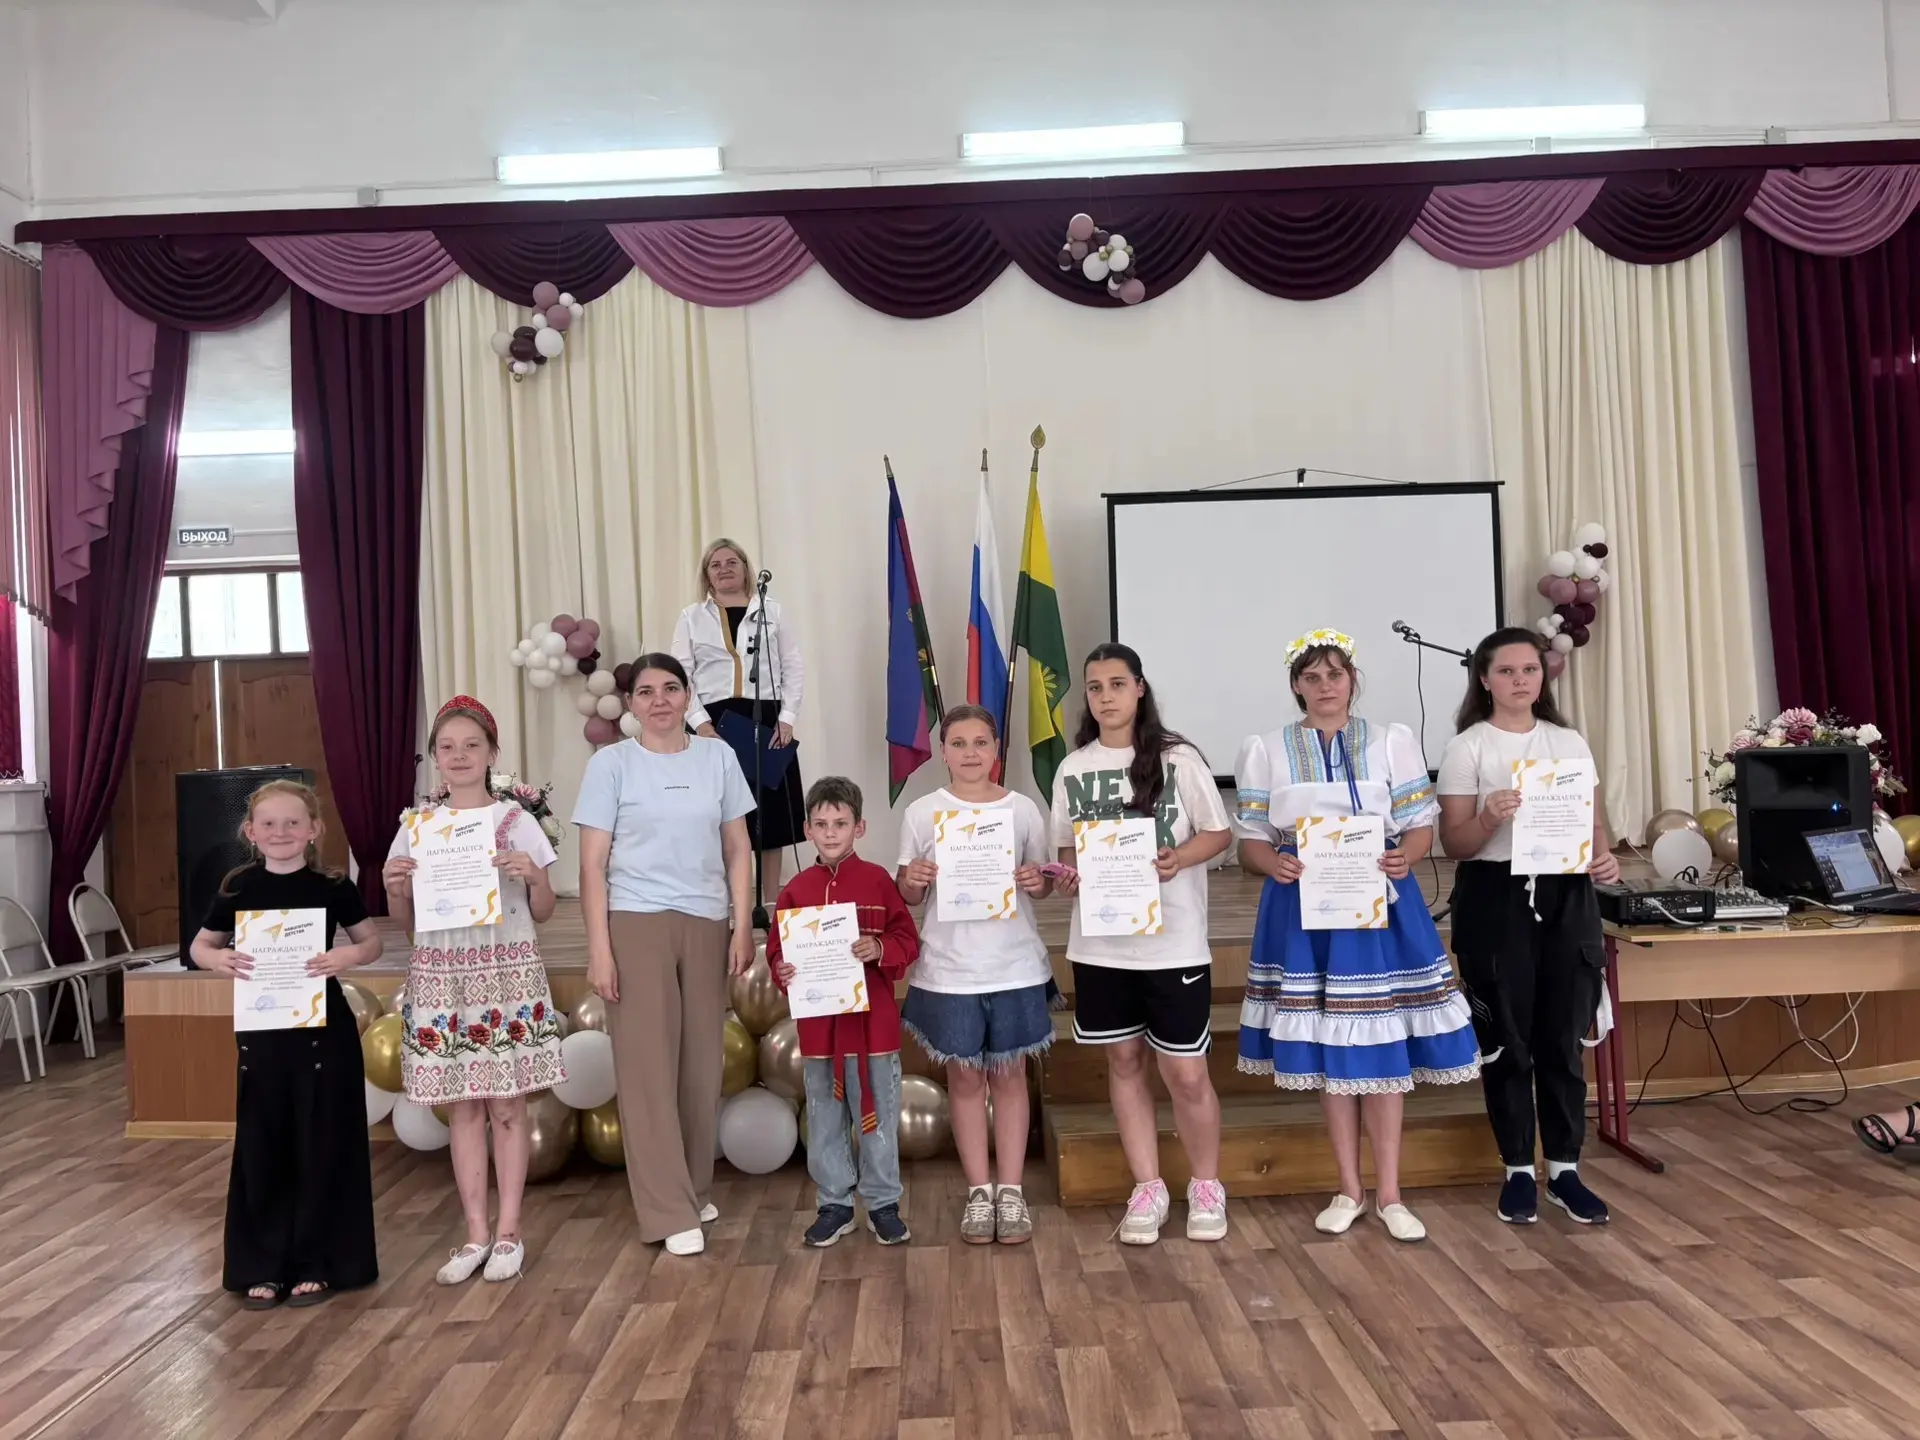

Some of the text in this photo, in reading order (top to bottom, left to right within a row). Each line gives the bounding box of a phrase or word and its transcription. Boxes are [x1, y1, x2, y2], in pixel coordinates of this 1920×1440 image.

[182, 531, 228, 542] ВЫХОД
[1556, 772, 1582, 780] НАВИГАТОРЫ
[1556, 778, 1575, 786] ДЕТСТВА
[1528, 794, 1582, 802] НАГРАЖДАЕТСЯ
[454, 821, 482, 833] НАВИГАТОРЫ
[977, 821, 1003, 831] НАВИГАТОРЫ
[455, 829, 474, 837] ДЕТСТВА
[978, 828, 995, 836] ДЕТСТВА
[1118, 832, 1145, 841] НАВИГАТОРЫ
[1343, 829, 1372, 838] НАВИГАТОРЫ
[1119, 838, 1137, 846] ДЕТСТВА
[426, 844, 484, 857] НАГРАЖДАЕТСЯ
[950, 844, 1003, 852] НАГРАЖДАЕТСЯ
[1092, 854, 1146, 862] НАГРАЖДАЕТСЯ
[821, 916, 847, 927] НАВИГАТОРЫ
[284, 922, 314, 932] НАВИГАТОРЫ
[822, 923, 840, 932] ДЕТСТВА
[284, 929, 304, 938] ДЕТСТВА
[796, 939, 849, 949] НАГРАЖДАЕТСЯ
[252, 946, 313, 954] НАГРАЖДАЕТСЯ
